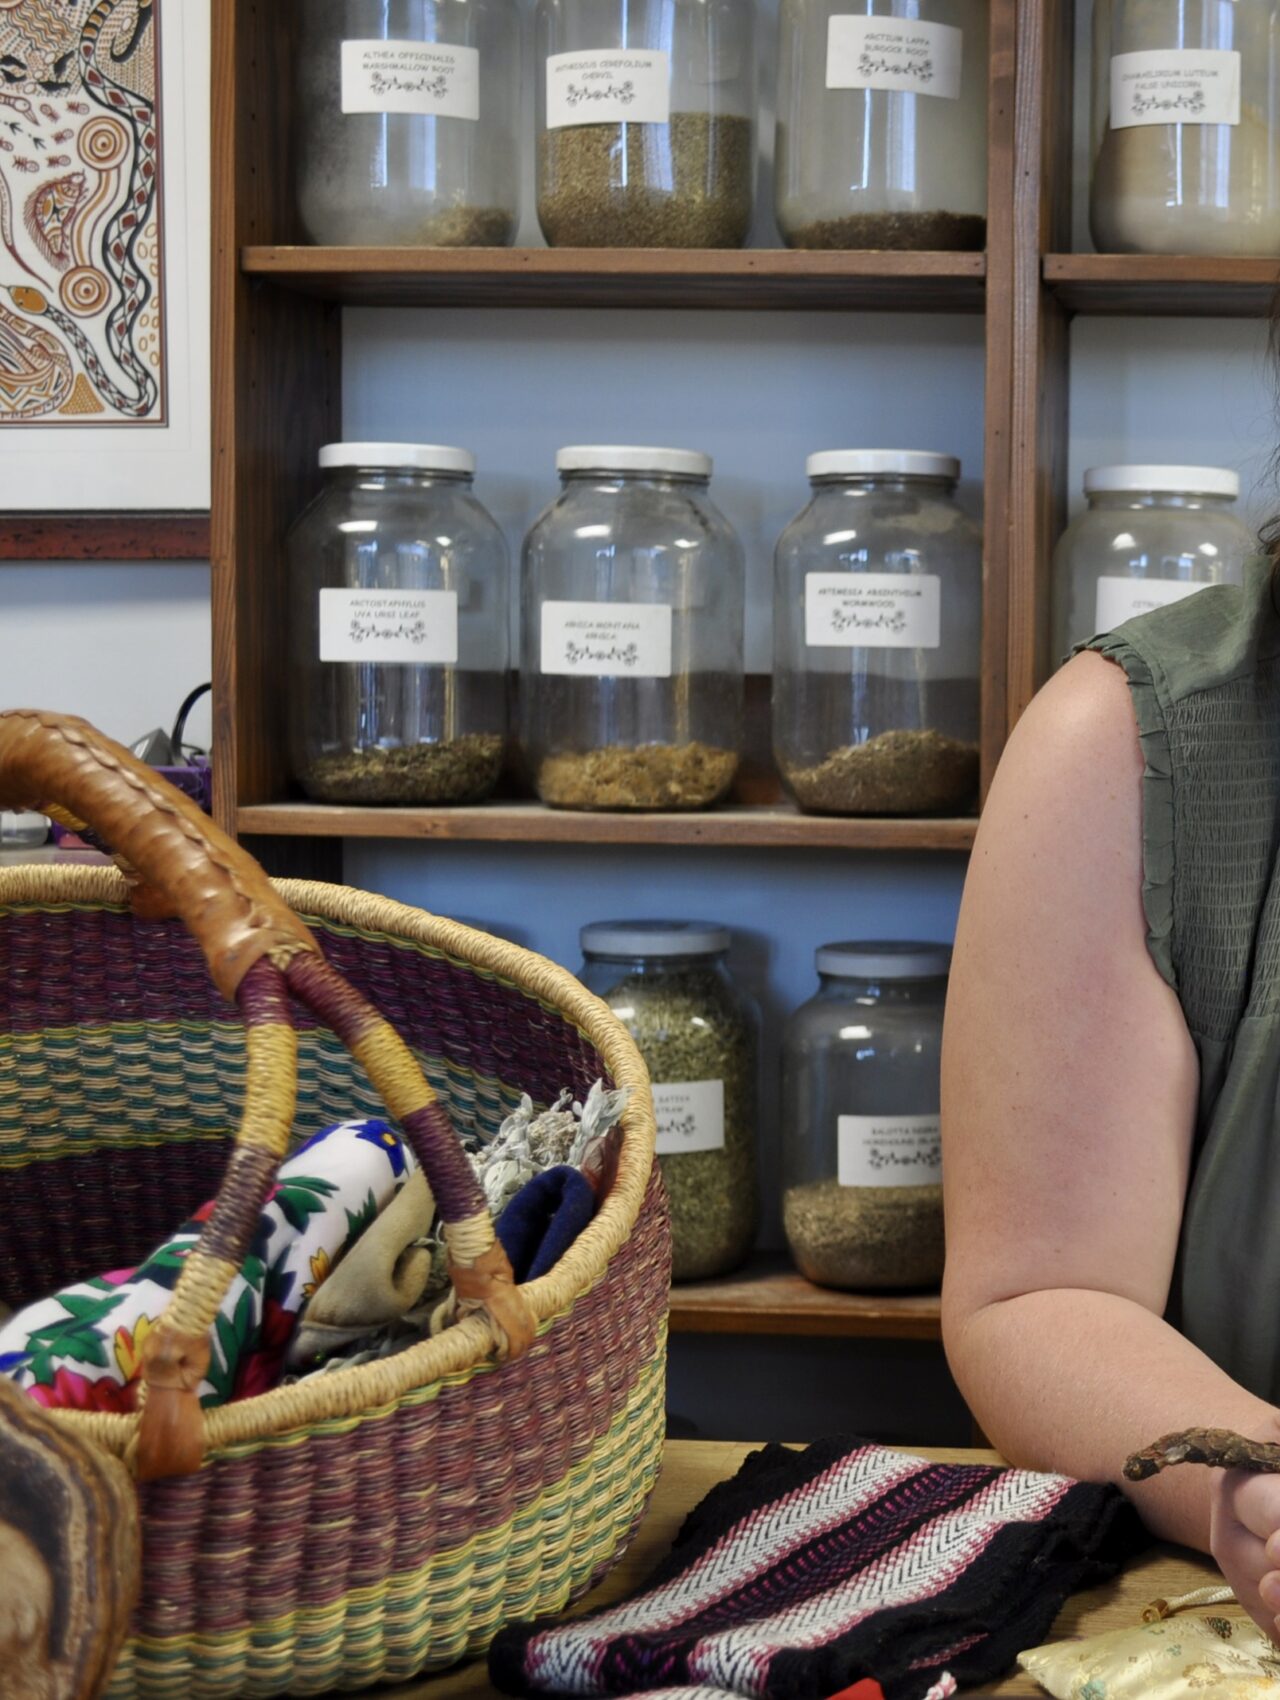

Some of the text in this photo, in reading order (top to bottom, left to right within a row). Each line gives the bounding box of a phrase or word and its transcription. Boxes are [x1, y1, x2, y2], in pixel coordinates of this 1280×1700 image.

[864, 33, 930, 46] ARCTIUM LAPPA
[906, 47, 929, 57] ROOT
[363, 51, 455, 64] ALTHEA OFFICINALIS
[363, 62, 455, 75] MARSHMALLOW ROOT
[841, 600, 895, 609] WORMWOOD
[354, 610, 420, 619] UVA URSI LEAF
[596, 621, 640, 631] MONTANA
